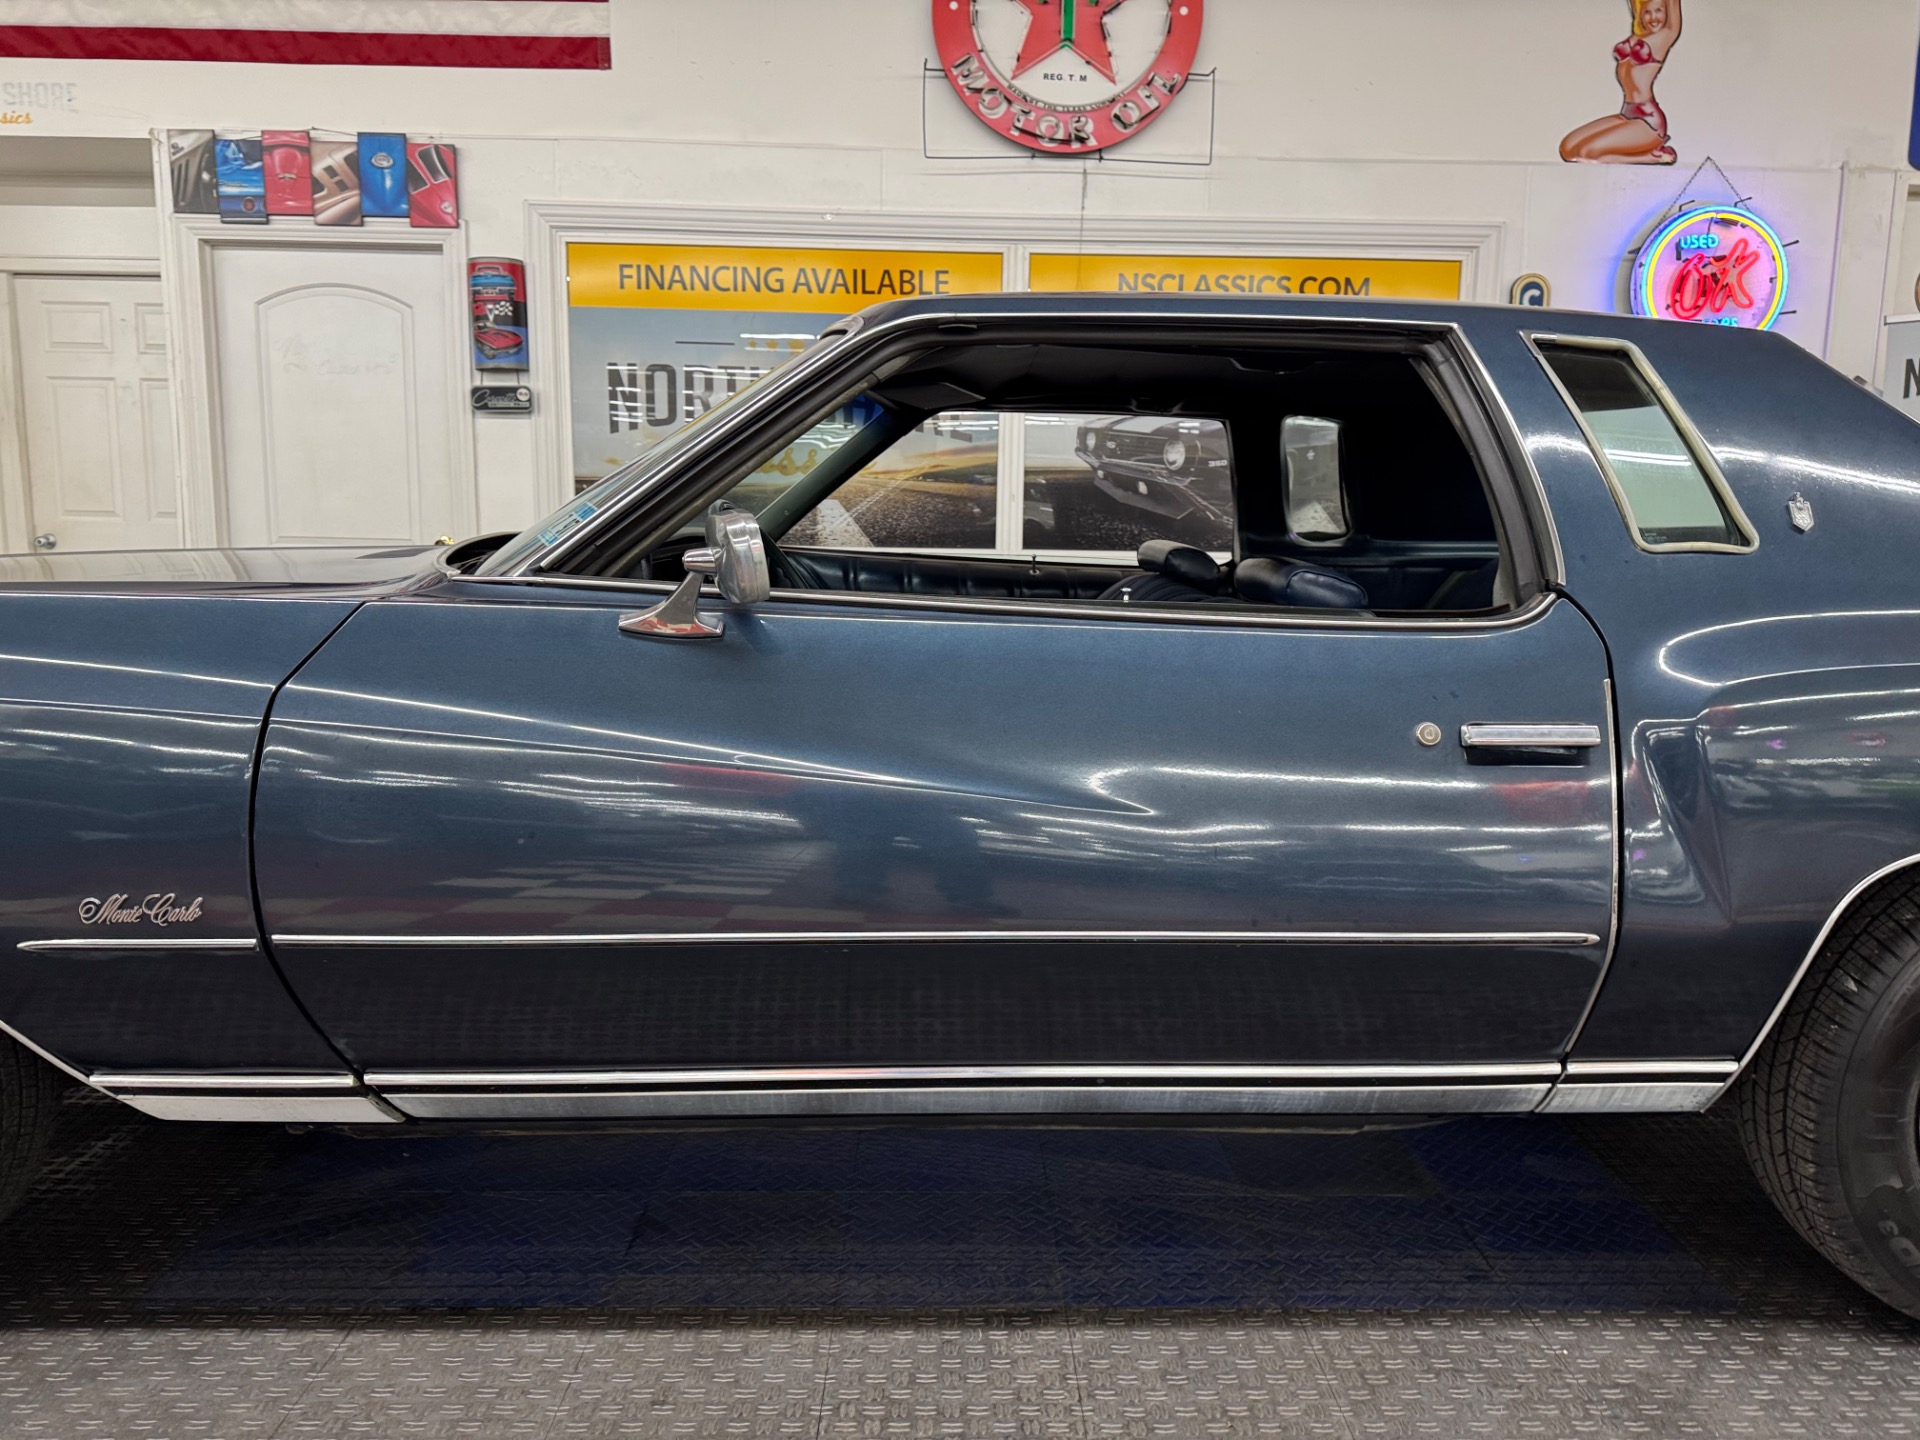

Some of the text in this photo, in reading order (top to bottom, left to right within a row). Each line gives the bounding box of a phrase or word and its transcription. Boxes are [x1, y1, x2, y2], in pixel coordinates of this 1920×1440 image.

[2, 82, 78, 113] SHORE
[951, 53, 1180, 148] MOTOR OIL
[1679, 234, 1719, 249] USED
[618, 263, 951, 295] FINANCING AVAILABLE
[1671, 237, 1760, 320] OK
[79, 892, 203, 927] Monte Carlo
